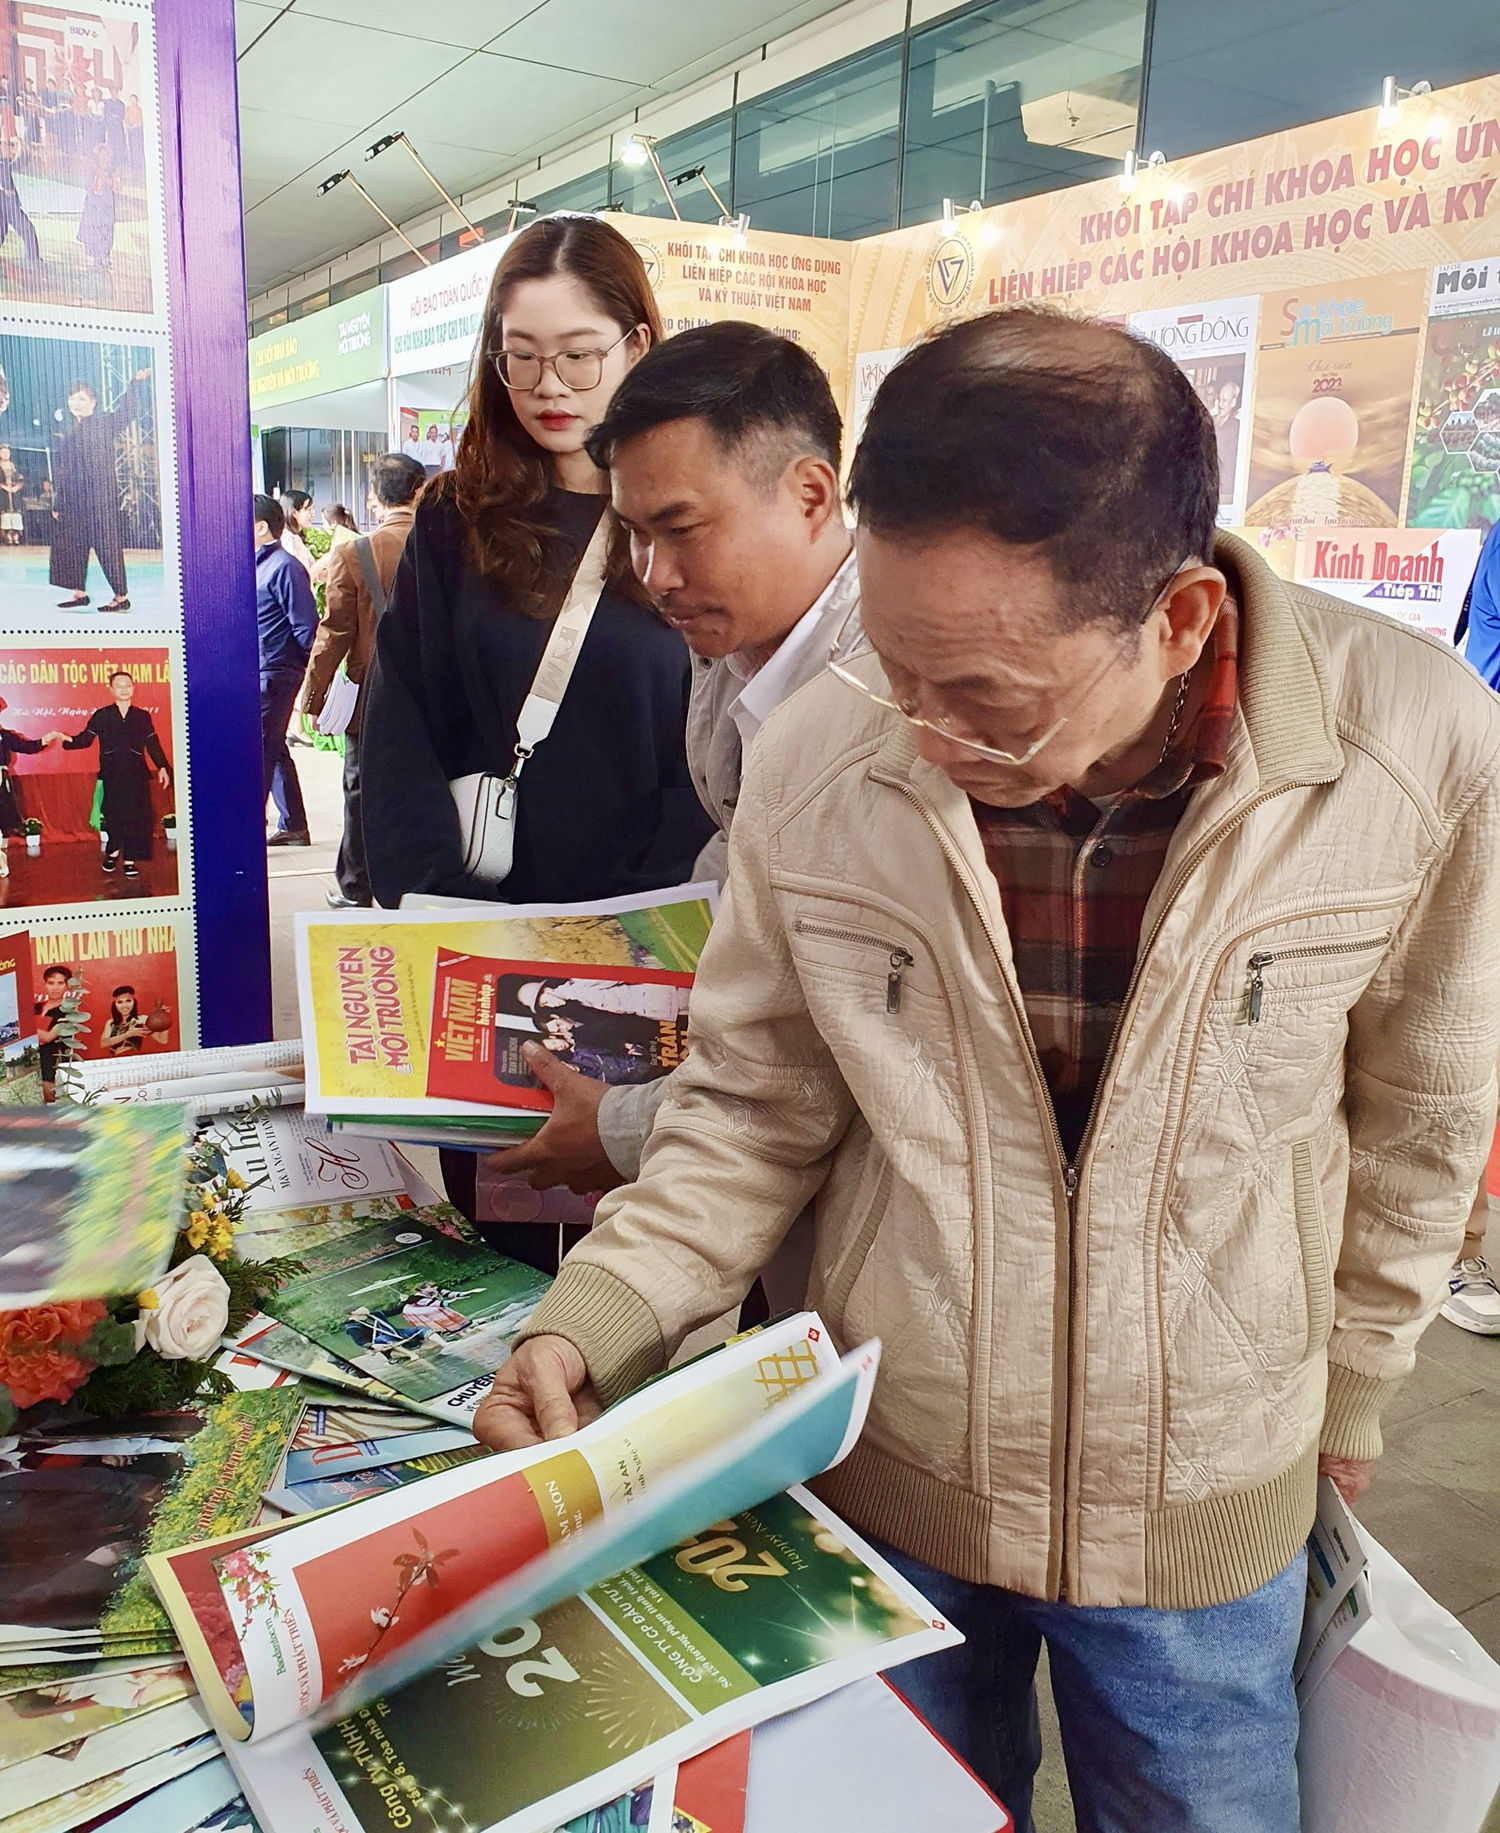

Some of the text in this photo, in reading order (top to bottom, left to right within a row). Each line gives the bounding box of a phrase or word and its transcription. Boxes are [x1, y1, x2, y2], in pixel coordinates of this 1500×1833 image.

[1080, 195, 1141, 245] KHỐI
[1151, 191, 1197, 235] TẠP
[1207, 169, 1255, 218] CHÍ
[1265, 153, 1355, 206] KHOA
[1367, 135, 1442, 186] HỌC
[989, 172, 1498, 304] LIÊN HIỆP CÁC HỘI KHOA HỌC VÀ KỸ
[668, 238, 693, 258] KHỐI
[718, 246, 736, 262] CHÍ
[739, 251, 765, 267] KHOA
[769, 254, 788, 272] HỌC
[792, 254, 812, 272] ỨNG
[815, 260, 841, 278] DỤNG
[682, 263, 827, 296] LIÊN HIỆP CÁC HỘI KHOA HỌC
[1436, 266, 1489, 295] Môi
[698, 285, 811, 312] VÀ KỸ THUẬT VIỆT NAM
[677, 314, 696, 330] chí
[1200, 316, 1249, 341] ĐÔNG
[1313, 540, 1445, 583] Kinh Doanh
[1384, 582, 1415, 600] Tiếp
[1418, 584, 1442, 602] Thị
[30, 659, 59, 684] DÂN
[62, 659, 88, 688] TỘC
[35, 933, 74, 966] NAM
[368, 945, 403, 1028] TRƯỜNG
[335, 947, 377, 1064] TÀI NGUYÊN
[441, 978, 480, 1061] VIỆT NAM
[766, 1534, 808, 1570] Happy
[603, 1587, 702, 1682] CÔNG TY CP ĐẦU TƯ
[654, 1613, 679, 1636] Phạm
[292, 1644, 307, 1672] PHÁT
[336, 1717, 374, 1766] TNHH
[366, 1718, 385, 1740] nhà
[380, 1739, 397, 1764] Tòa
[302, 1767, 323, 1793] TRIỂN
[317, 1792, 335, 1814] PHÁT
[380, 1783, 412, 1830] Công
